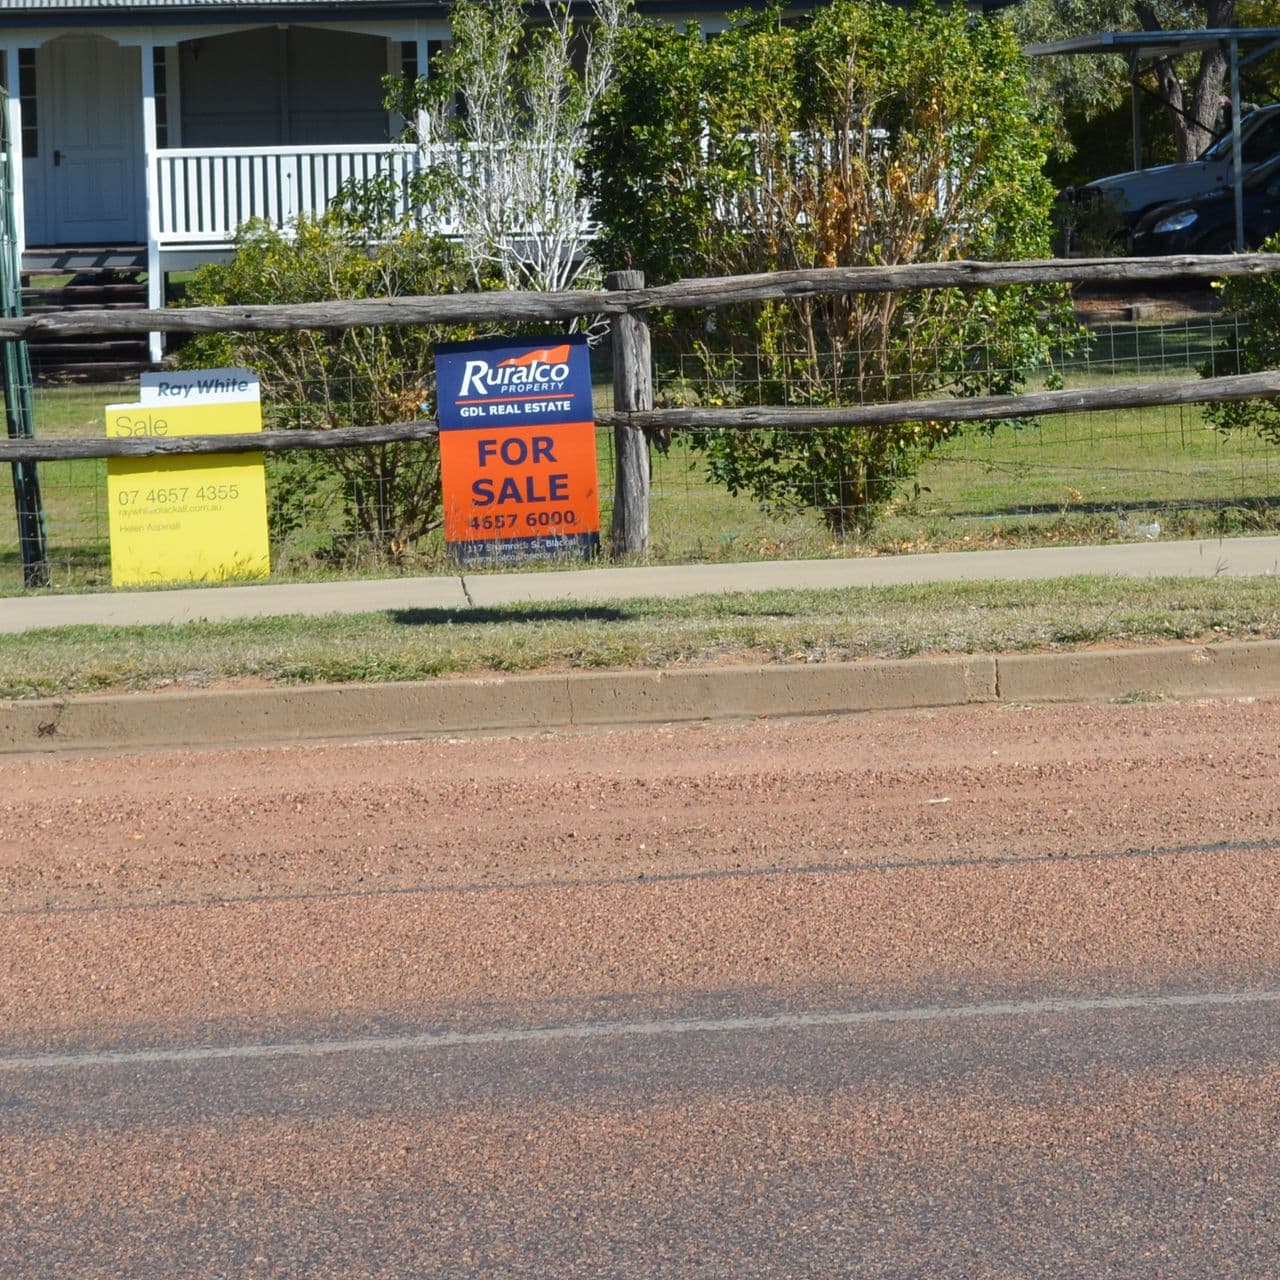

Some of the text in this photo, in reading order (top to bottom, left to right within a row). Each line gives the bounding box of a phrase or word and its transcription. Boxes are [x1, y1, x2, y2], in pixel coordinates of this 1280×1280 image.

[158, 378, 248, 398] Ray White
[458, 359, 570, 397] Ruralco
[501, 381, 564, 394] PROPERTY
[460, 401, 571, 417] GDL REAL ESTATE
[116, 414, 168, 438] Sale
[478, 436, 557, 467] FOR
[118, 484, 239, 506] 07 4657 4355
[471, 473, 569, 507] SALE
[470, 510, 576, 530] 4657 6000
